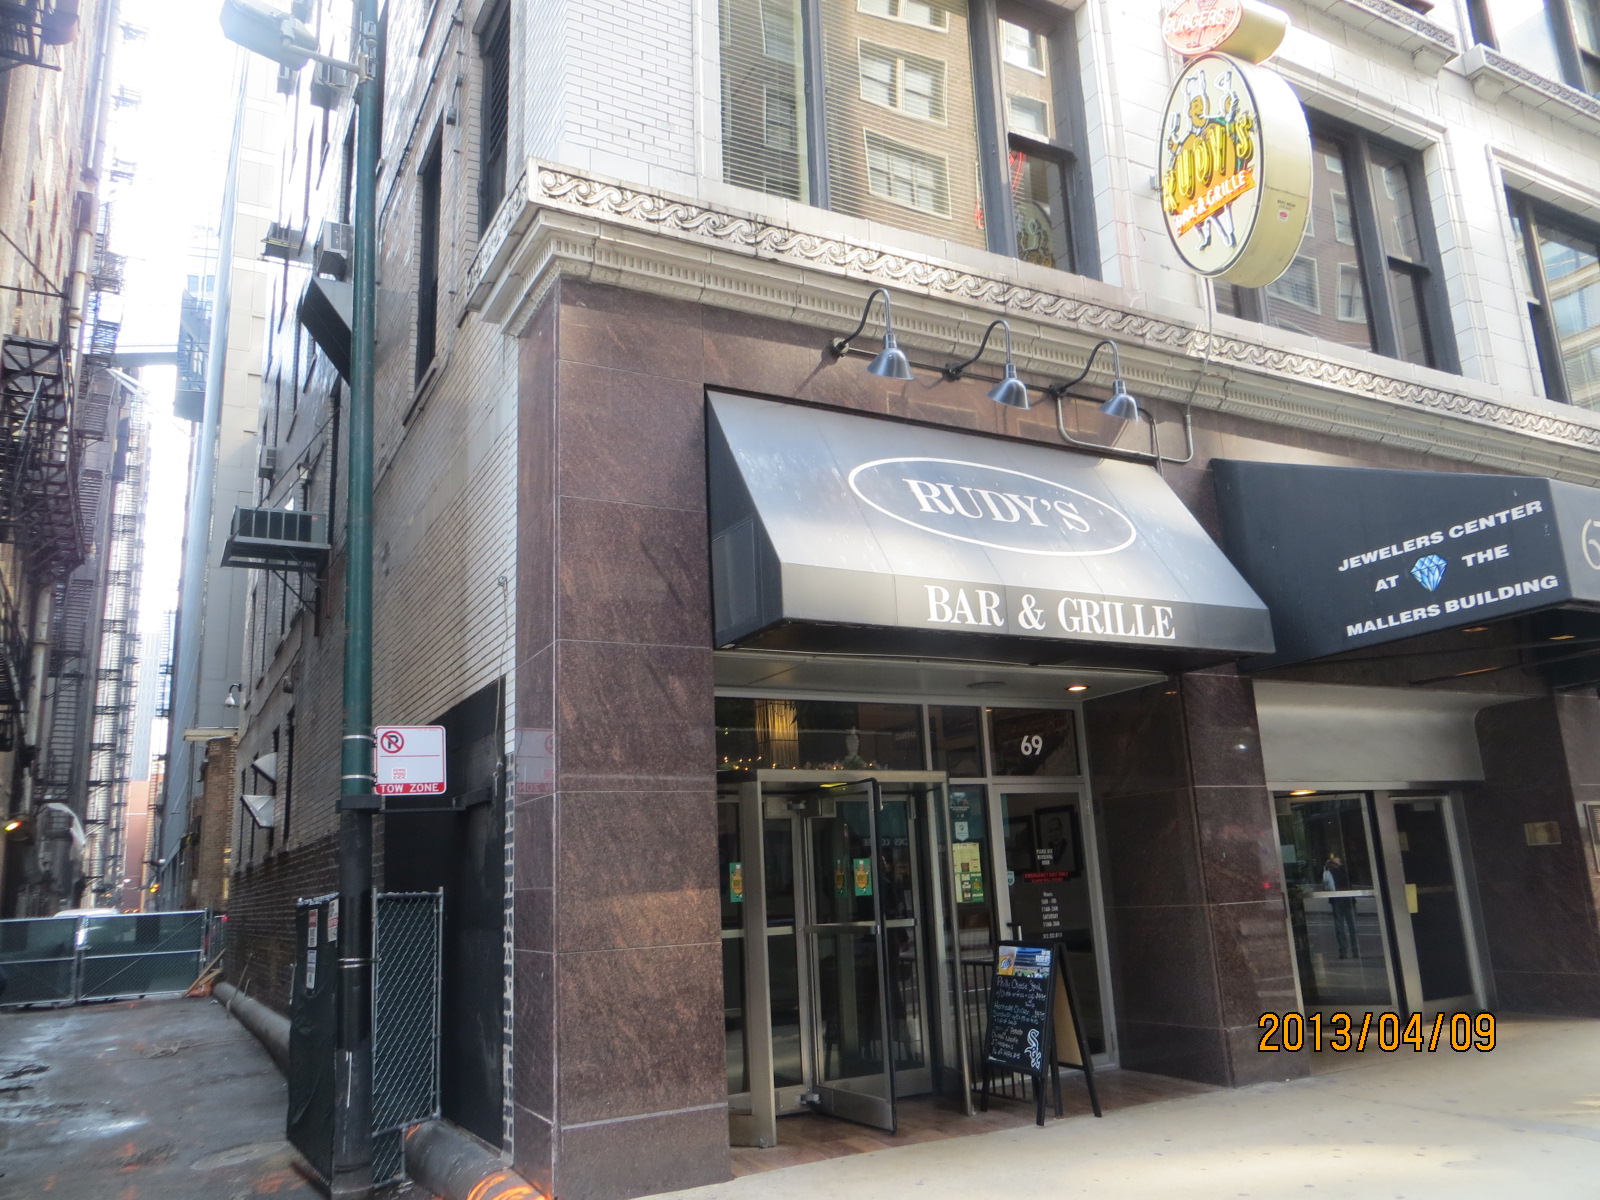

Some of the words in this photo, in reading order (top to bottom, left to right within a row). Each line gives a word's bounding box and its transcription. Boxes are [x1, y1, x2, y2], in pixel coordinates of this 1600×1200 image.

[1165, 7, 1226, 33] BURGERS
[1163, 113, 1253, 213] RUDY'S
[1206, 169, 1247, 206] GRILLE
[902, 477, 1091, 534] RUDY'S
[1338, 530, 1445, 572] JEWELERS
[1449, 500, 1543, 539] CENTER
[1375, 575, 1399, 592] AT
[1461, 544, 1510, 568] THE
[924, 584, 1005, 627] BAR
[1017, 594, 1046, 631] &
[1057, 597, 1176, 640] GRILLE
[1346, 604, 1441, 637] MALLERS
[1445, 574, 1559, 614] BUILDING
[1020, 735, 1043, 756] 69
[380, 784, 404, 793] TOW
[409, 783, 440, 793] ZONE
